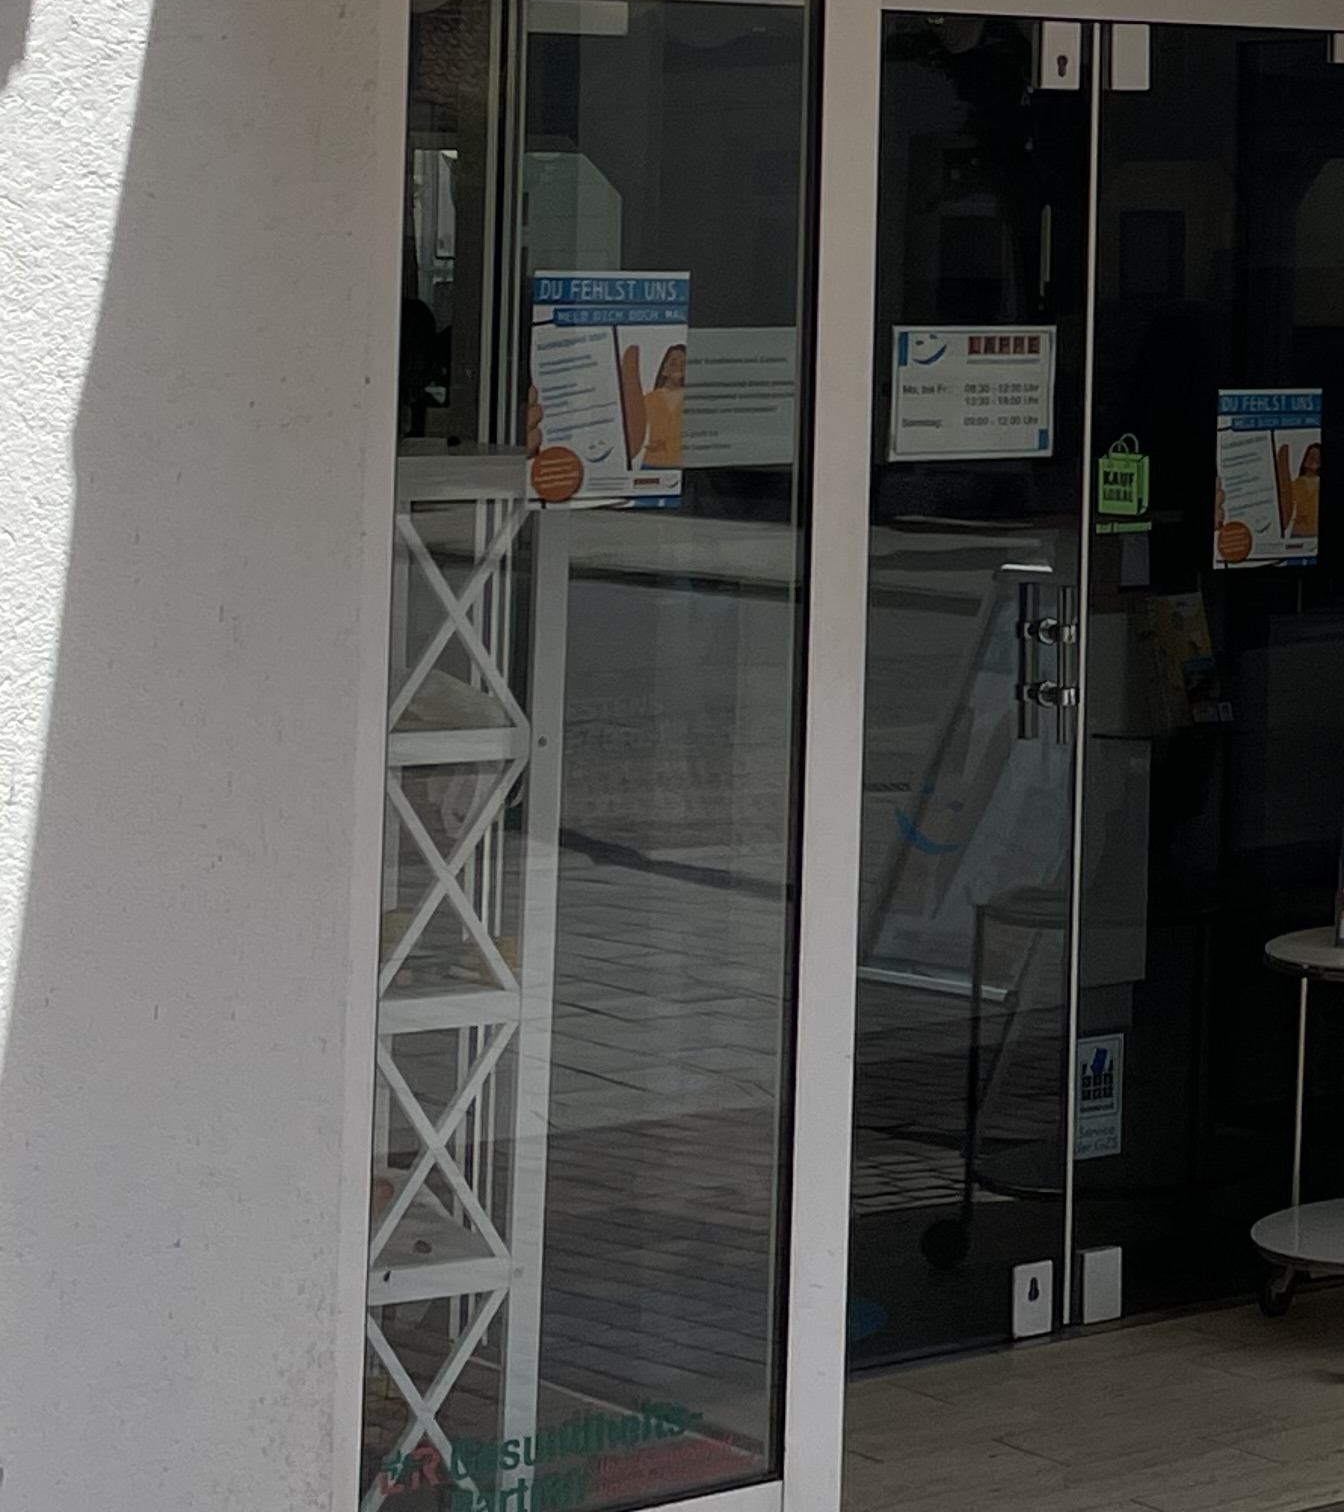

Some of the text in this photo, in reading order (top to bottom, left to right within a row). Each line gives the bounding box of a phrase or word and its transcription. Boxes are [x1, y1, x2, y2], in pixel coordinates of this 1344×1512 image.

[539, 279, 562, 300] DU
[569, 280, 637, 301] FEHLST
[1103, 470, 1134, 486] KAUF
